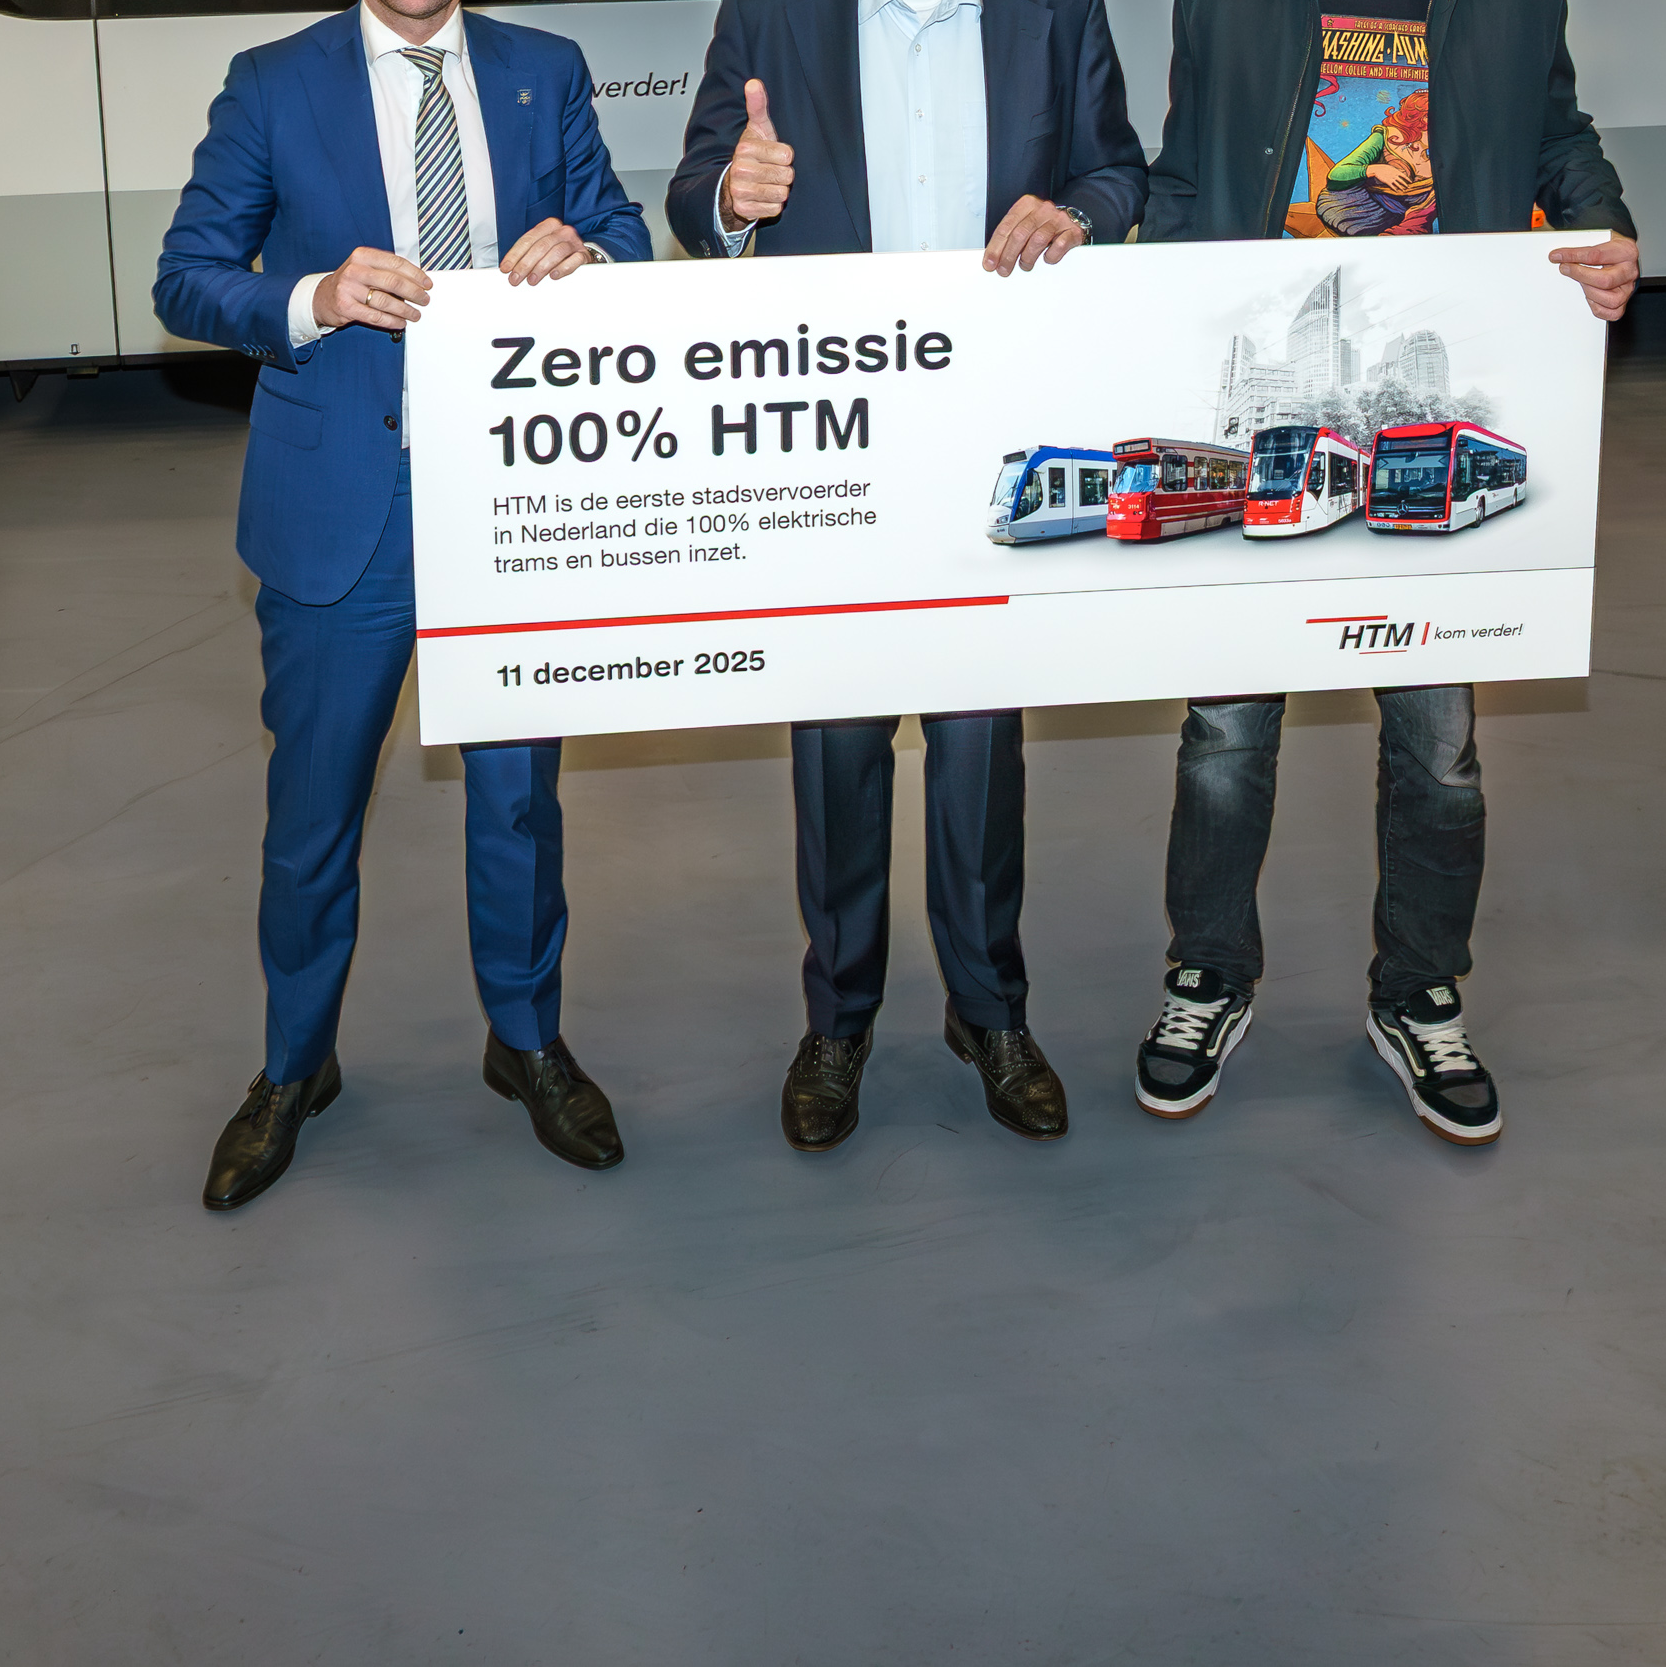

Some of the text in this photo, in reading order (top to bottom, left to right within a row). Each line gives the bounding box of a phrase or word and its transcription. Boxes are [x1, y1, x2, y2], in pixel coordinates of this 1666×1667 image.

[592, 72, 689, 99] verder!
[1345, 65, 1367, 77] COLLIE
[1369, 66, 1384, 77] AND
[1385, 67, 1398, 79] THE
[1400, 68, 1429, 81] INFINITE
[490, 319, 953, 390] Zero emissie
[488, 397, 869, 467] 100% HTM
[493, 479, 871, 516] HTM is de eerste stadsvervoerder
[494, 507, 877, 545] in Nederland die 100% elektrische
[493, 543, 746, 574] trams en bussen inzet.
[1338, 622, 1524, 650] HTM kom verder!
[496, 649, 766, 688] 11 december 2025
[1176, 969, 1202, 988] VANS
[1425, 986, 1454, 1006] VANS
